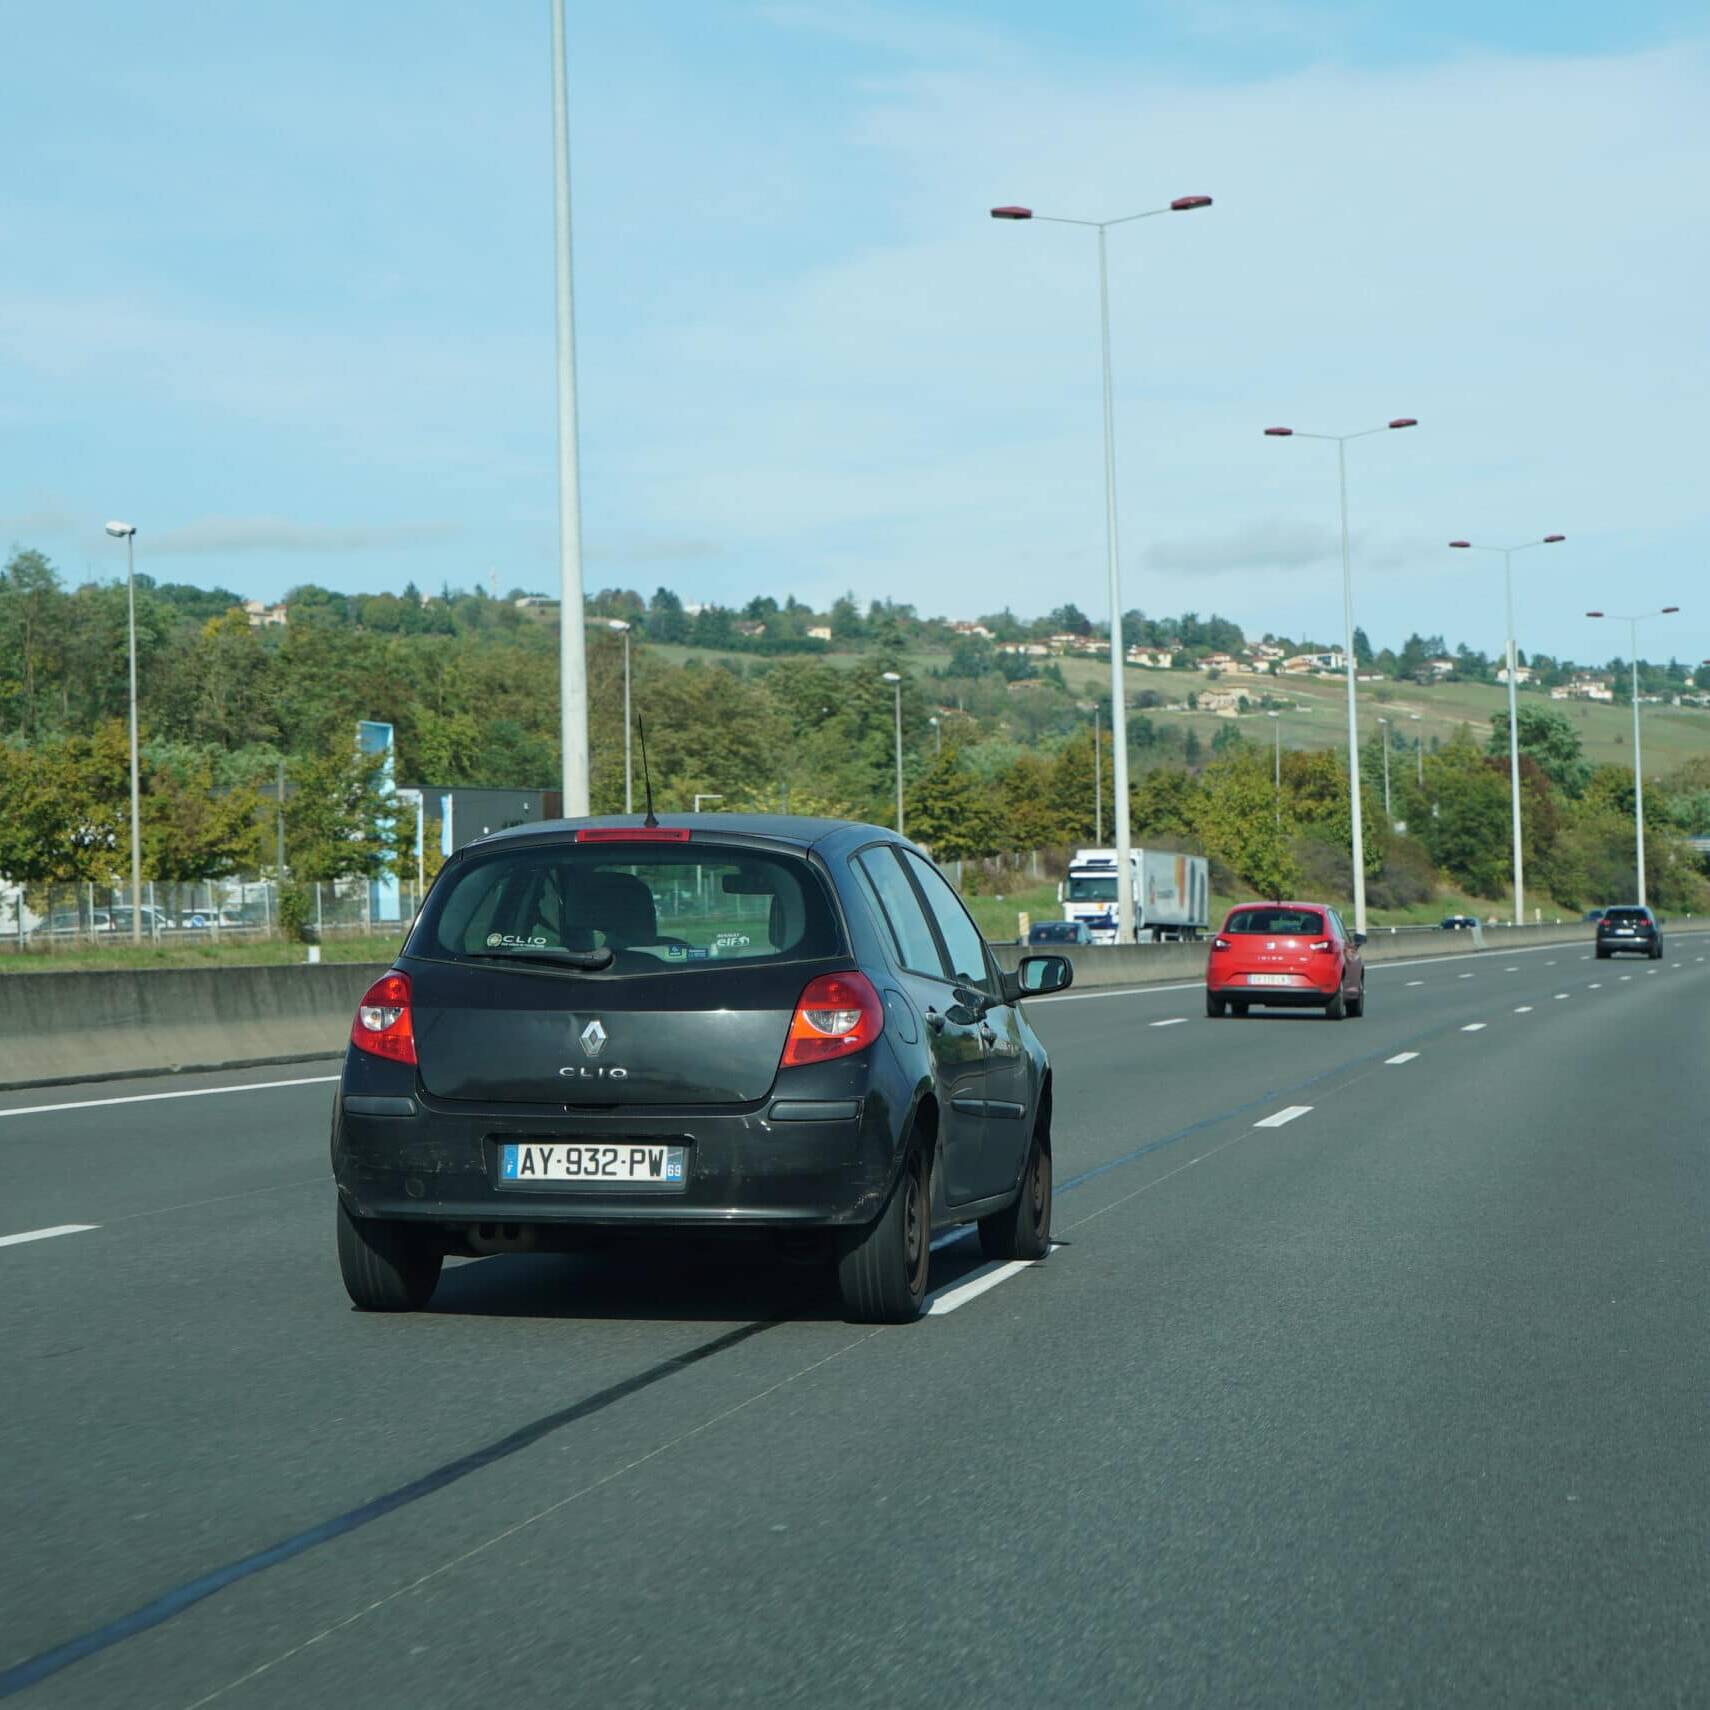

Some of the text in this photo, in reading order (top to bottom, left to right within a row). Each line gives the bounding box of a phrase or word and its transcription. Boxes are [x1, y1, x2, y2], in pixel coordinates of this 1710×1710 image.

[502, 935, 547, 945] CLIO
[559, 1067, 627, 1078] CLIO
[667, 1164, 682, 1177] 69
